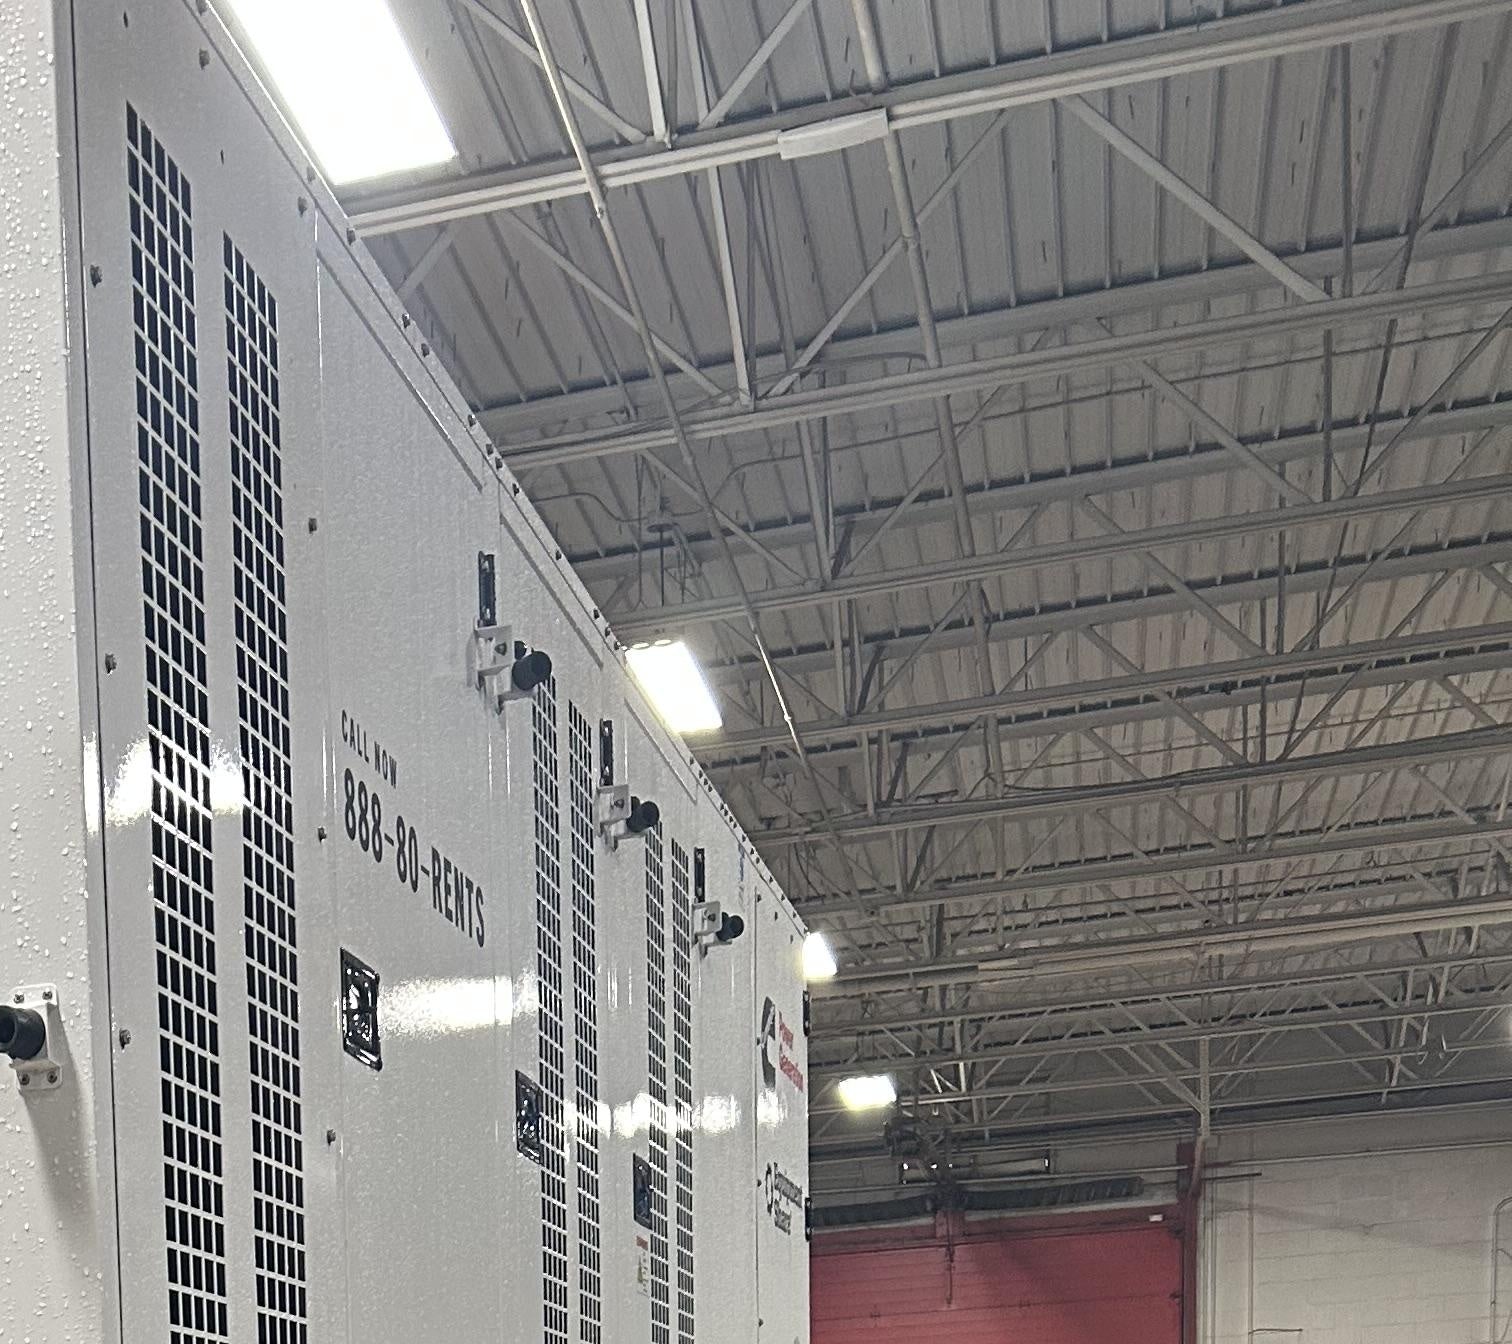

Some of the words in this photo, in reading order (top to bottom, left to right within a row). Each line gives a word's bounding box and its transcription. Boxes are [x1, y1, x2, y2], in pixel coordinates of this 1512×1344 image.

[341, 709, 370, 763] CALL
[374, 740, 397, 790] NOW
[344, 767, 485, 948] 888-80-RENTS
